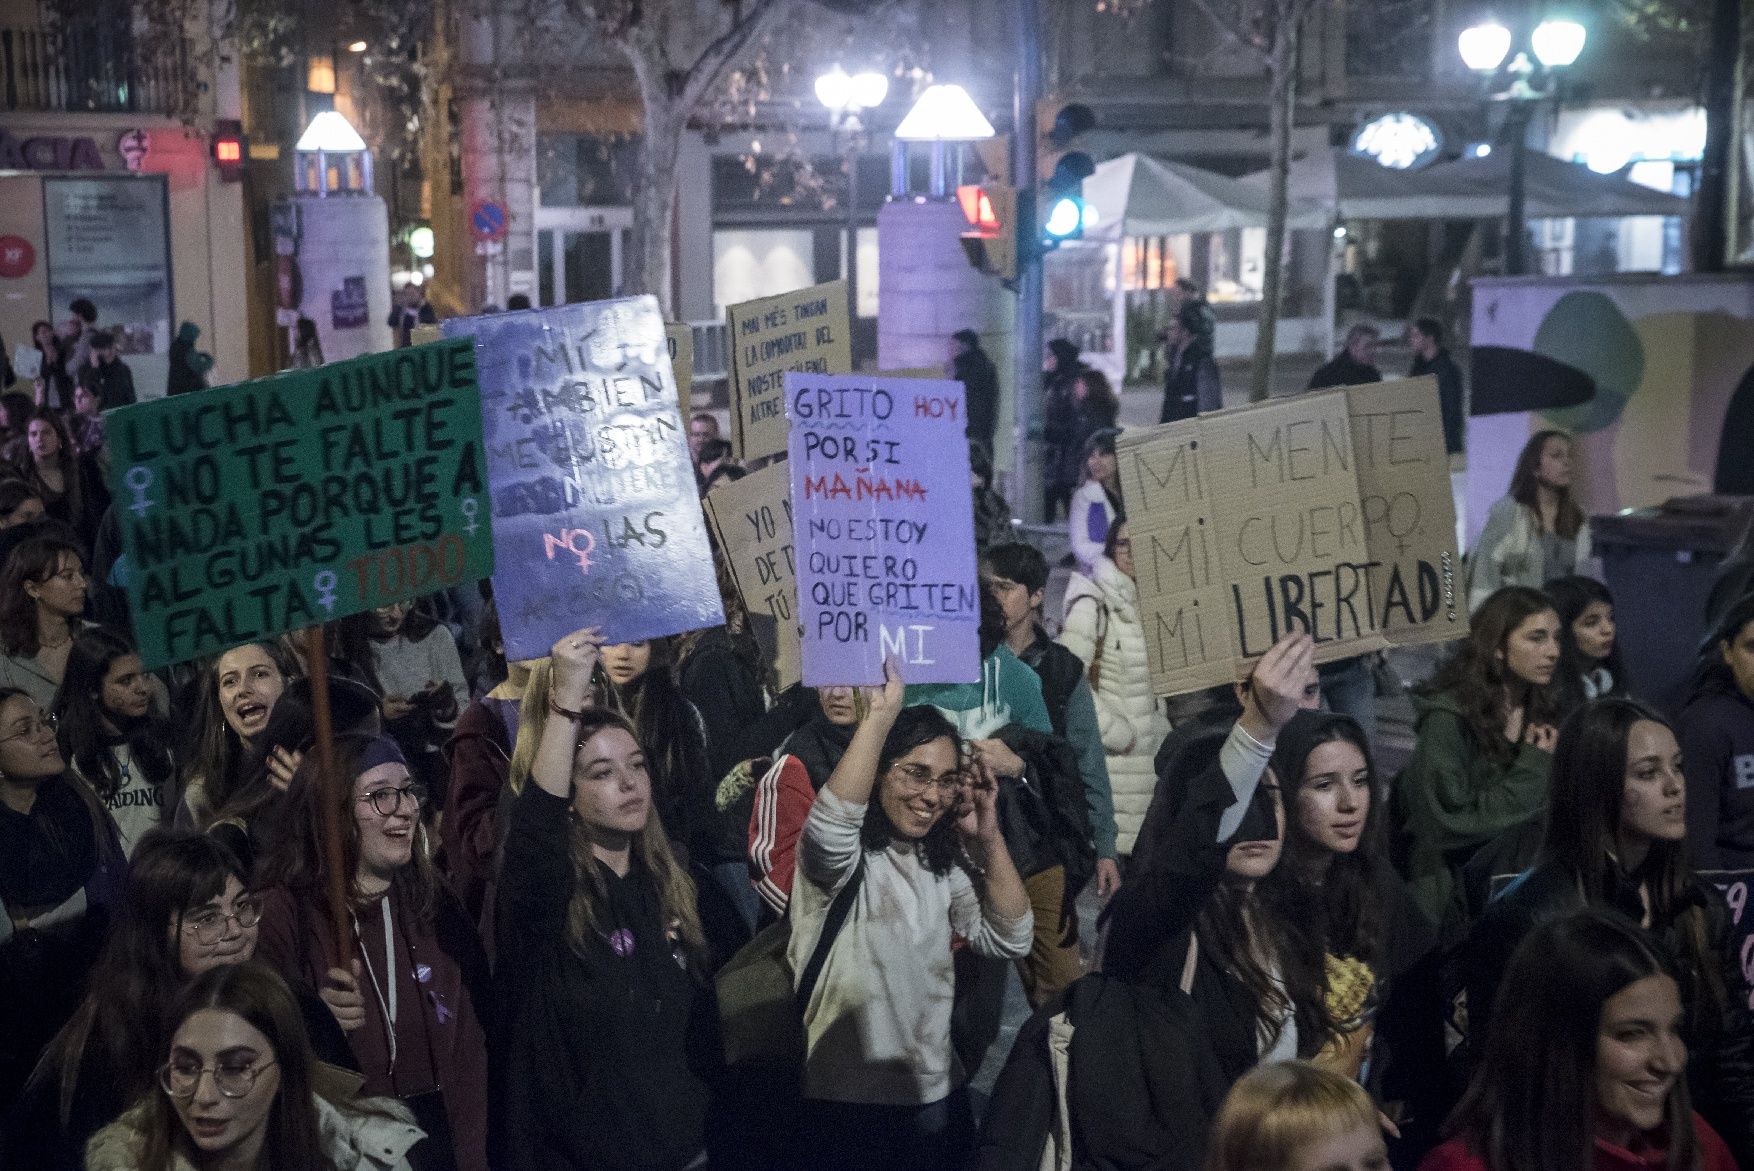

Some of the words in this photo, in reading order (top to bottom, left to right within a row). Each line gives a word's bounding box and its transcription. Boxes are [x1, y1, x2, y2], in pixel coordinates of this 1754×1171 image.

[127, 397, 296, 461] LUCHA
[313, 345, 477, 420] AUNQUE
[794, 388, 894, 420] GRITO
[913, 396, 958, 421] HOY
[165, 454, 218, 509] NO
[234, 439, 300, 488] TE
[320, 399, 456, 471] FALTE
[804, 431, 858, 463] POR
[866, 439, 901, 464] SI
[1248, 409, 1430, 489] MENTE
[804, 467, 927, 502] MAÑANA
[134, 509, 246, 569] NADA
[261, 456, 439, 535] PORQUE
[453, 442, 481, 497] A
[746, 505, 776, 543] YO
[603, 511, 667, 550] LAS
[809, 518, 841, 540] NO
[848, 518, 928, 544] ESTOY
[1238, 491, 1422, 567] CUERPO
[142, 523, 341, 610] ALGUNAS
[363, 504, 444, 550] LES
[754, 550, 782, 586] DE
[809, 551, 918, 581] QUIERO
[165, 577, 315, 658] FALTA
[347, 535, 465, 603] TODO
[764, 588, 791, 624] TÚ
[812, 581, 858, 607] QUE
[868, 582, 975, 612] GRITEN
[818, 610, 869, 643] POR
[879, 623, 936, 665] MI
